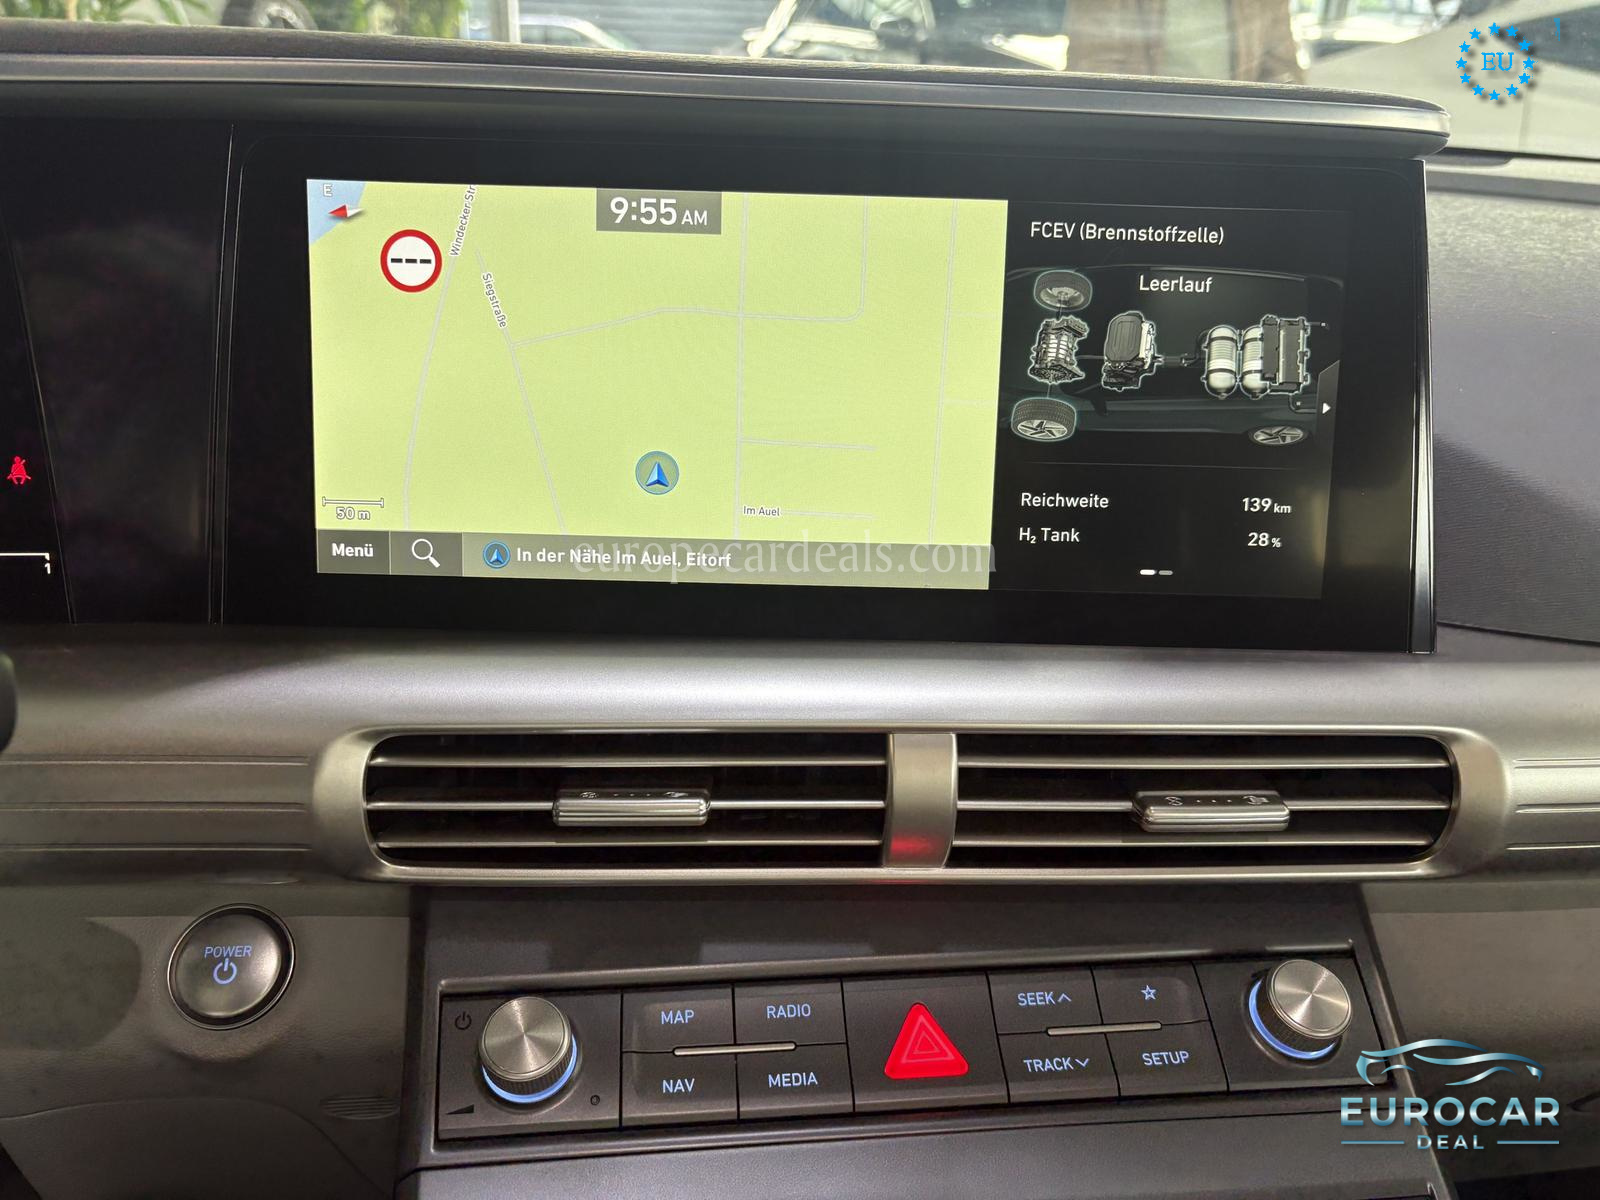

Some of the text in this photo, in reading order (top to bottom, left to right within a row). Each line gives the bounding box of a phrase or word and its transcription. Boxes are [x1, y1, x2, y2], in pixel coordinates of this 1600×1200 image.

[322, 183, 334, 197] E
[609, 196, 708, 226] 9:55 AM
[450, 202, 471, 256] Windecker
[1030, 222, 1225, 245] FCEV (Brennstoffzelle)
[1139, 275, 1213, 293] Leerlauf
[482, 272, 507, 329] Siegstraße
[743, 505, 781, 518] Im Auel
[1020, 492, 1293, 514] Reichweite 139 km
[336, 507, 371, 520] 50 m
[1041, 527, 1081, 543] Tank
[1247, 532, 1270, 547] 28
[1271, 536, 1282, 548] %
[331, 543, 374, 558] Menü
[517, 548, 732, 568] In der Nähe Im Auel, Eitorf
[204, 945, 252, 958] POWER
[1017, 991, 1055, 1007] SEEK
[660, 1009, 695, 1025] MAP
[766, 1003, 812, 1020] RADIO
[1023, 1056, 1074, 1074] TRACK
[1142, 1050, 1190, 1067] SETUP
[662, 1078, 696, 1094] NAV
[767, 1071, 819, 1089] MEDIA
